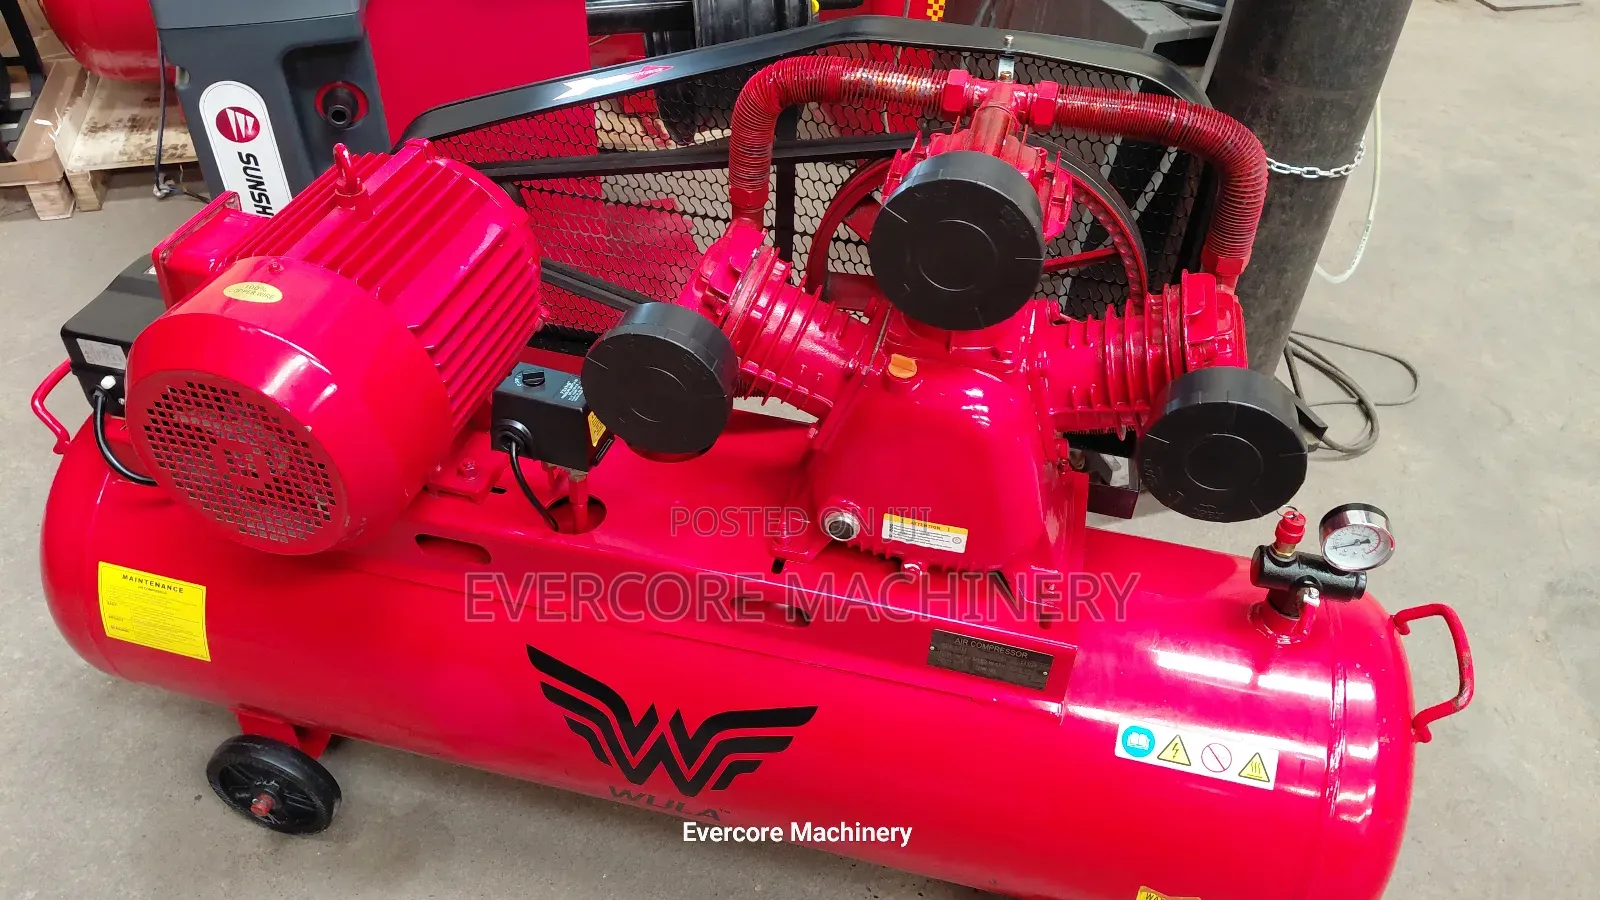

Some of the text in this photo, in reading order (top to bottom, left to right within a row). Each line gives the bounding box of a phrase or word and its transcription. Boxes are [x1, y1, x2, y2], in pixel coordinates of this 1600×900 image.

[121, 574, 184, 594] MAINTENANCE
[954, 637, 969, 646] AIR
[970, 640, 1029, 659] COMPRESSOR
[608, 785, 721, 821] WULA
